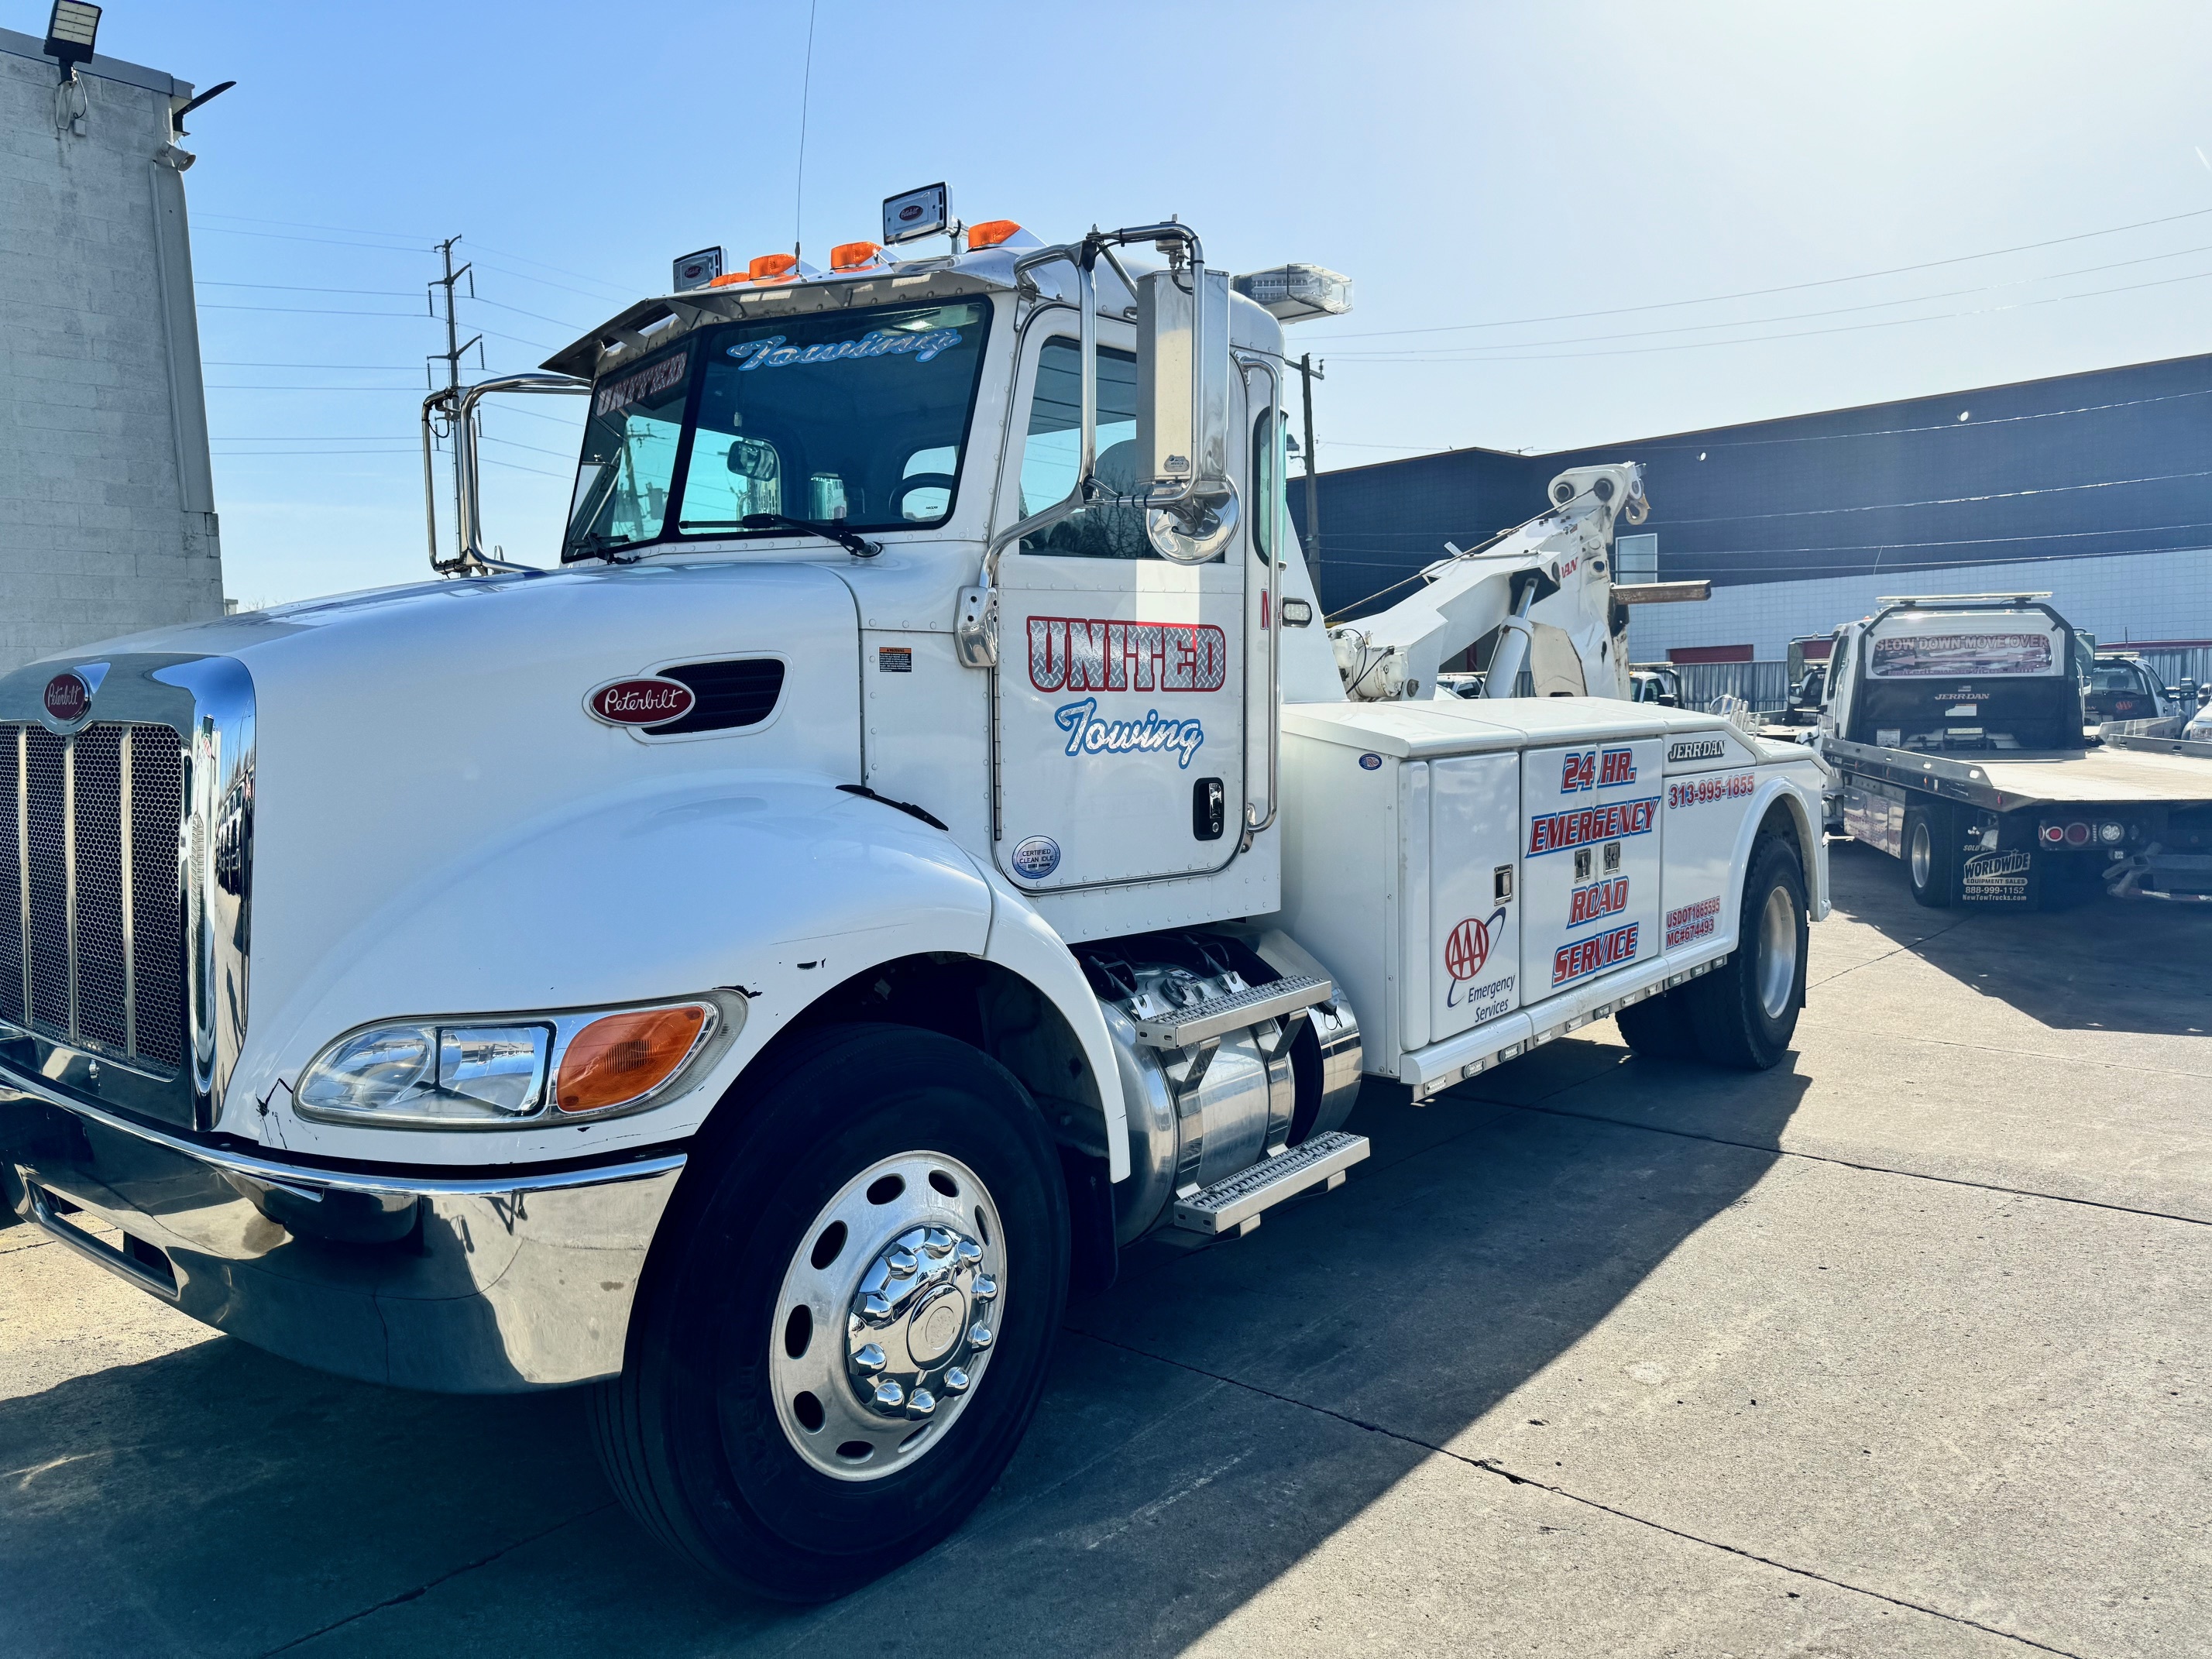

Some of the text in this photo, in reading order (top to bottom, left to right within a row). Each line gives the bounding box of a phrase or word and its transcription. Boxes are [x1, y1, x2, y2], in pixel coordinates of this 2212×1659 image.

[726, 328, 962, 371] Towing
[596, 352, 687, 417] UNITED
[1026, 616, 1226, 692] UNITED
[1875, 634, 2049, 652] SLOW DOWN MOVE OVER
[47, 682, 81, 708] Peterbilt
[604, 689, 683, 714] Peterbilt
[1055, 697, 1204, 769] Towing
[1561, 748, 1637, 794] 24 HR.
[1668, 772, 1755, 809] 313-995-1855
[1524, 795, 1662, 859] EMERGENCY
[1964, 852, 2031, 880] WORLDWIDE
[1566, 875, 1630, 929] ROAD
[1965, 886, 2025, 895] 888-999-1152
[1445, 918, 1489, 981] AAA
[1666, 915, 1714, 950] MC#674493
[1551, 921, 1639, 989] SERVICE
[1468, 974, 1516, 1004] Emergency
[1475, 998, 1509, 1023] Services
